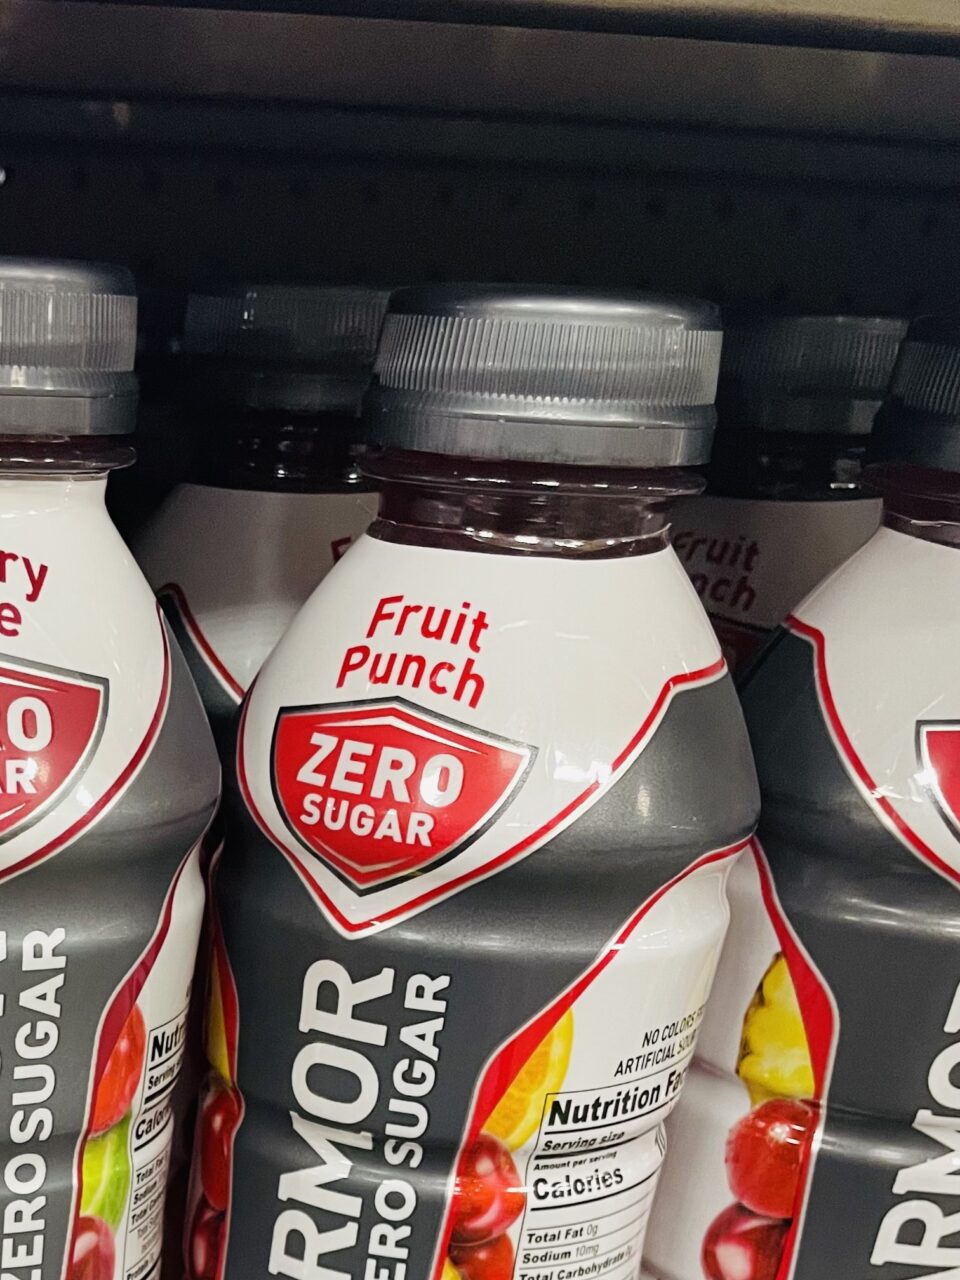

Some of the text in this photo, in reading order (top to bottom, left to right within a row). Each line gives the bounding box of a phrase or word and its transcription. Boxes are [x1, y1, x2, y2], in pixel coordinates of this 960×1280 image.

[366, 594, 490, 655] Fruit
[336, 645, 486, 710] Punch
[296, 731, 465, 808] ZERO
[299, 793, 435, 848] SUGAR
[10, 927, 67, 1144] SUGAR
[642, 1028, 660, 1048] NO
[384, 973, 452, 1169] SUGAR
[613, 1044, 676, 1078] ARTIFICIAL
[547, 1083, 662, 1127] Nutrition
[542, 1131, 626, 1152] Serving size
[533, 1151, 618, 1172] Amount per serving
[533, 1168, 624, 1201] Calories
[527, 1223, 599, 1245] Total Fat 0g
[522, 1243, 600, 1265] Sodium 10mg
[557, 1251, 625, 1280] Carbohydrate
